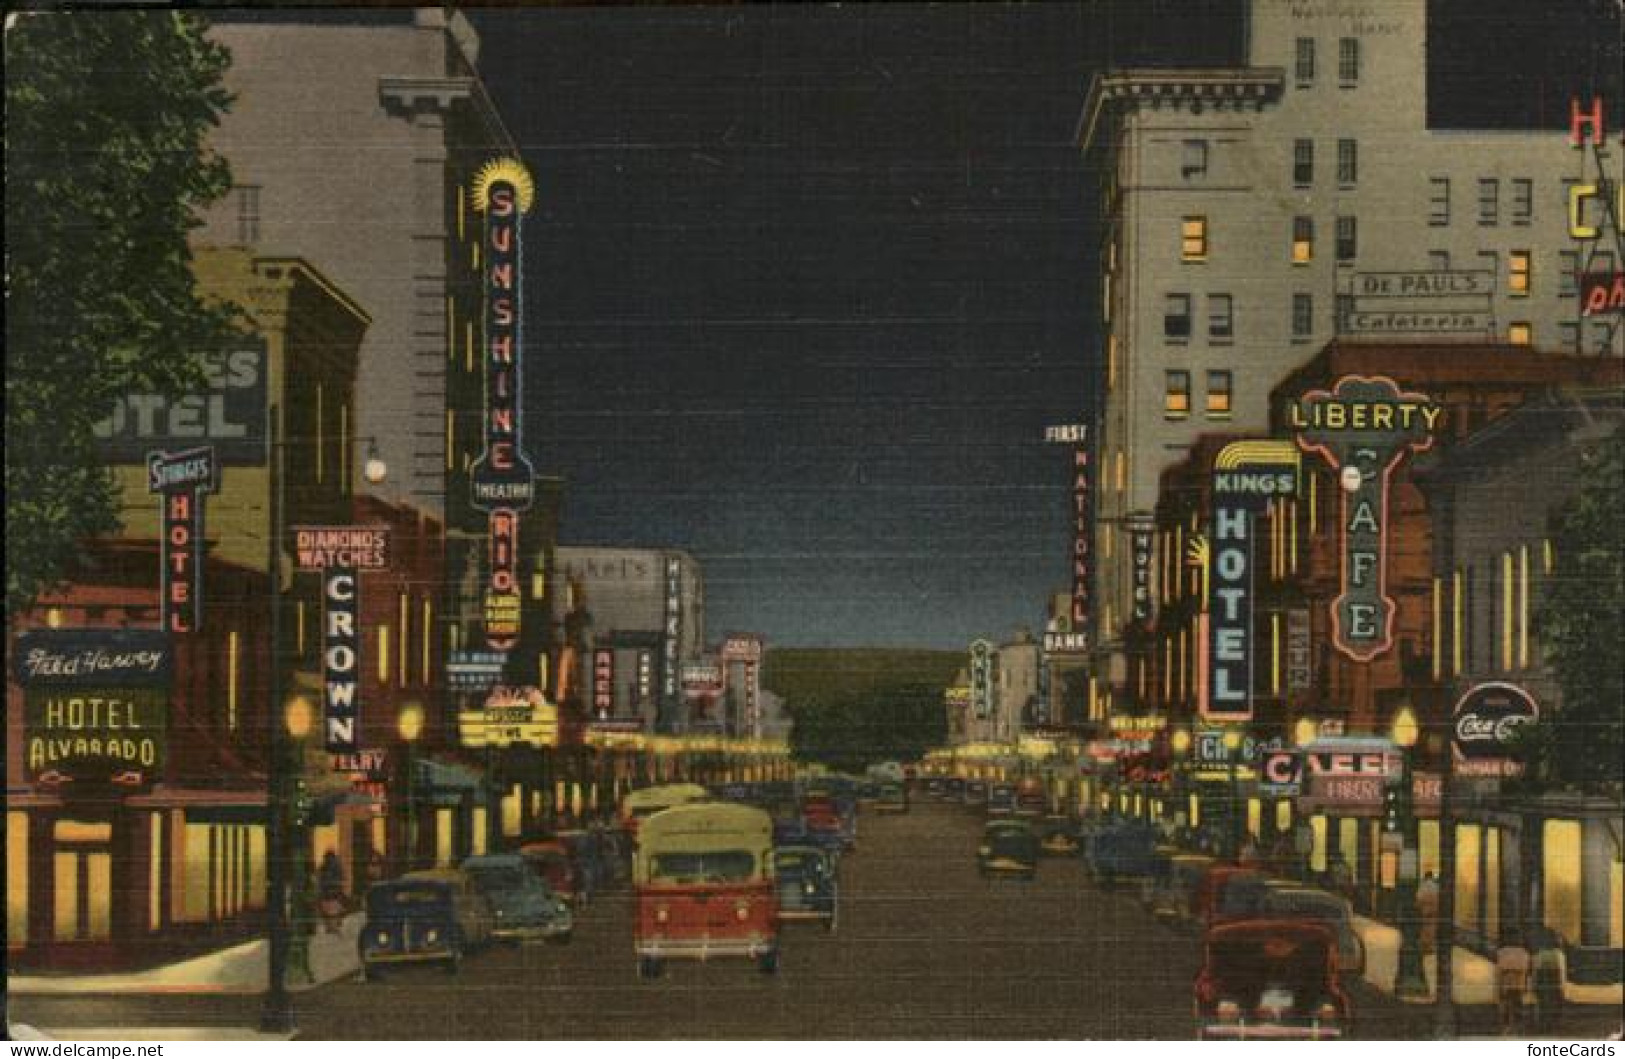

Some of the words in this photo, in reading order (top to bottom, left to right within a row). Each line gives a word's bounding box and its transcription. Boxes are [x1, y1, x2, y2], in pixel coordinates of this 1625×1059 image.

[491, 190, 514, 470] SUNSHINE
[1356, 313, 1475, 328] Cafeteria
[1045, 424, 1088, 442] FIRST
[1292, 403, 1441, 430] LIBERTY
[476, 482, 530, 499] THEATRE
[1215, 473, 1294, 494] KINGS
[297, 531, 386, 548] DIAMONDS
[493, 514, 510, 589] RIO
[1073, 450, 1088, 622] NATIONAL
[1349, 448, 1378, 638] CAFE
[170, 494, 190, 632] HOTEL
[297, 550, 385, 567] WATCHES
[1136, 533, 1148, 618] HOTEL
[1215, 508, 1247, 701] HOTEL
[666, 559, 681, 696] HINKELS
[1044, 632, 1086, 650] BANK
[326, 575, 355, 743] CROWN
[46, 699, 141, 729] HOTEL
[29, 738, 156, 771] ALVARADO
